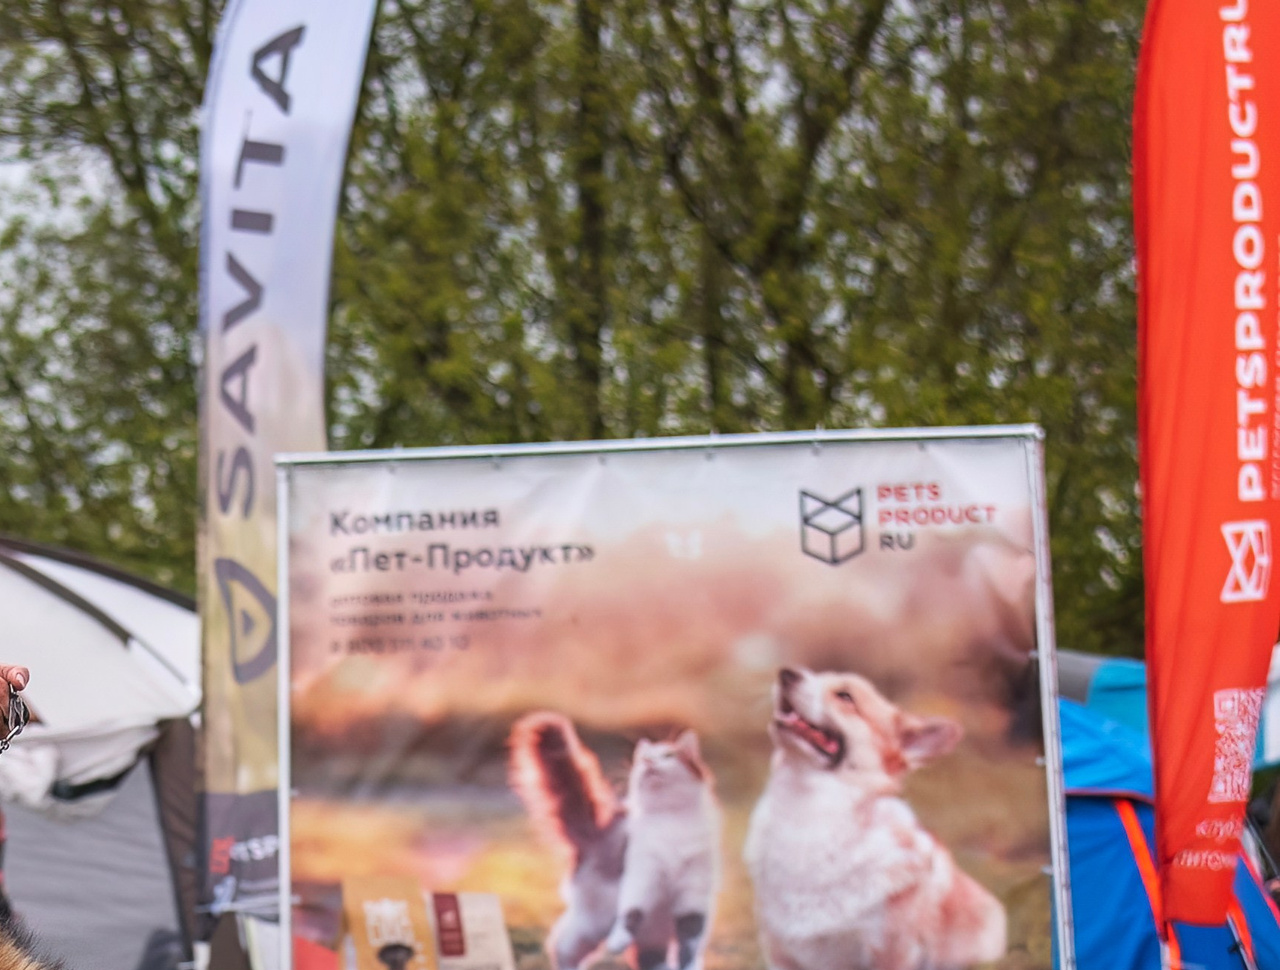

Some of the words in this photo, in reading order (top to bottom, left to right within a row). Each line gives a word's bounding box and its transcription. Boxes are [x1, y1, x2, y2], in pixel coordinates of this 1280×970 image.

[220, 24, 307, 521] SAVITA
[877, 483, 941, 502] PETS
[329, 508, 500, 535] Компания
[878, 505, 997, 526] PRODUCT
[880, 532, 916, 551] RU
[329, 542, 596, 574] «Пет-Продукт»
